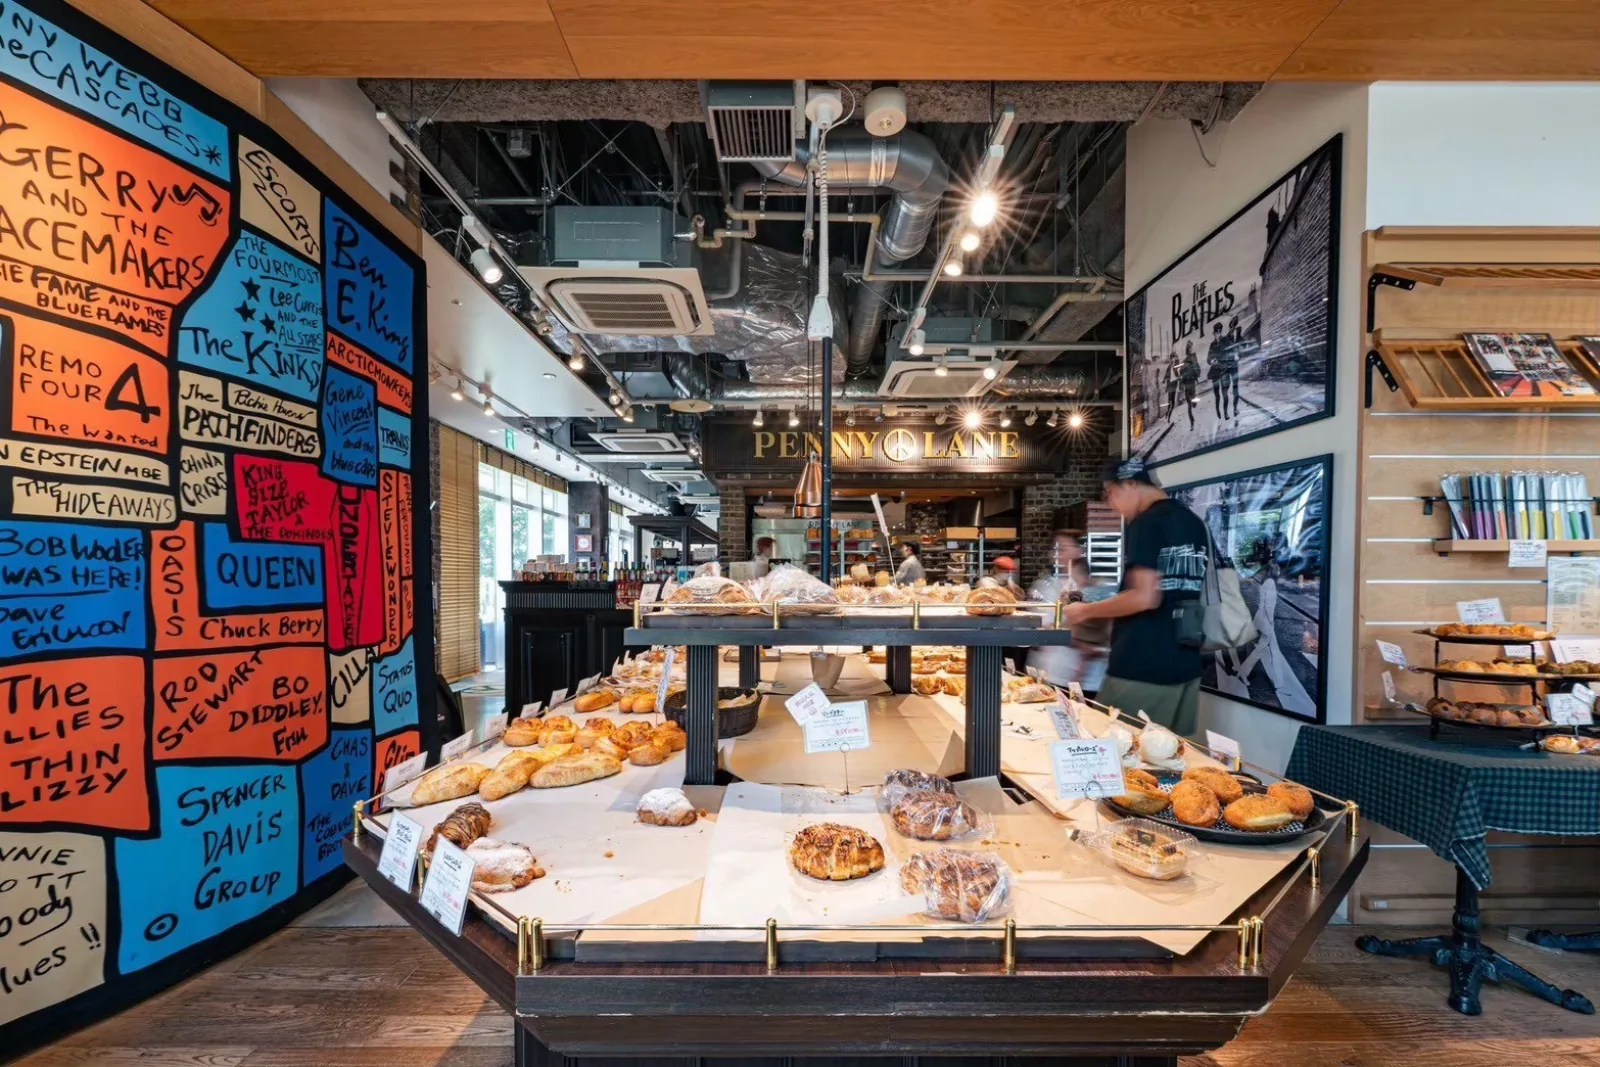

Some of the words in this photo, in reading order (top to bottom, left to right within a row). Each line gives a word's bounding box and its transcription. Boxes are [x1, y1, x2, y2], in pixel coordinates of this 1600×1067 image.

[80, 43, 182, 123] WEBB
[30, 50, 200, 158] CASCADES
[0, 145, 167, 213] GERRY
[22, 180, 88, 216] AND
[246, 150, 319, 255] ESCORTS
[101, 212, 173, 246] THE
[241, 237, 268, 255] THE
[235, 249, 320, 284] FOURMOST
[331, 216, 387, 290] Ben
[31, 266, 101, 302] FAME
[108, 295, 140, 311] AND
[145, 306, 168, 321] THE
[37, 292, 93, 318] BLUE
[270, 287, 292, 307] Lee
[1192, 280, 1208, 303] THE
[277, 310, 296, 322] AND
[299, 318, 318, 328] THE
[1172, 281, 1235, 345] BEATLES
[20, 344, 102, 378] REMO
[178, 327, 243, 362] The
[20, 373, 102, 402] FOUR
[105, 363, 161, 423] 4
[326, 381, 364, 406] Gene
[27, 415, 70, 435] The
[183, 405, 317, 454] PATHFINDERS
[753, 431, 879, 459] PENNY
[923, 431, 1020, 459] LANE
[20, 447, 121, 473] EPSTEIN
[125, 465, 162, 481] MBE
[180, 453, 224, 474] CHINA
[242, 464, 282, 488] KING
[17, 480, 62, 498] THE
[56, 492, 173, 520] HIDEAWAYS
[245, 491, 310, 527] TAYLOR
[3, 565, 61, 587] WAS
[72, 566, 141, 590] HERE!
[159, 536, 186, 637] OASIS
[217, 553, 316, 589] QUEEN
[200, 618, 271, 640] Chuck
[279, 616, 322, 637] Berry
[0, 674, 90, 714] The
[158, 650, 264, 751] STEWART
[160, 662, 218, 713] ROD
[272, 676, 310, 699] BO
[384, 690, 412, 713] QUO
[10, 743, 120, 780] THIN
[331, 737, 368, 760] CHAS
[0, 768, 128, 812] LIZZY
[177, 774, 286, 827] SPENCER
[331, 775, 367, 800] DAVE
[308, 812, 332, 831] THE
[194, 867, 281, 910] GROUP
